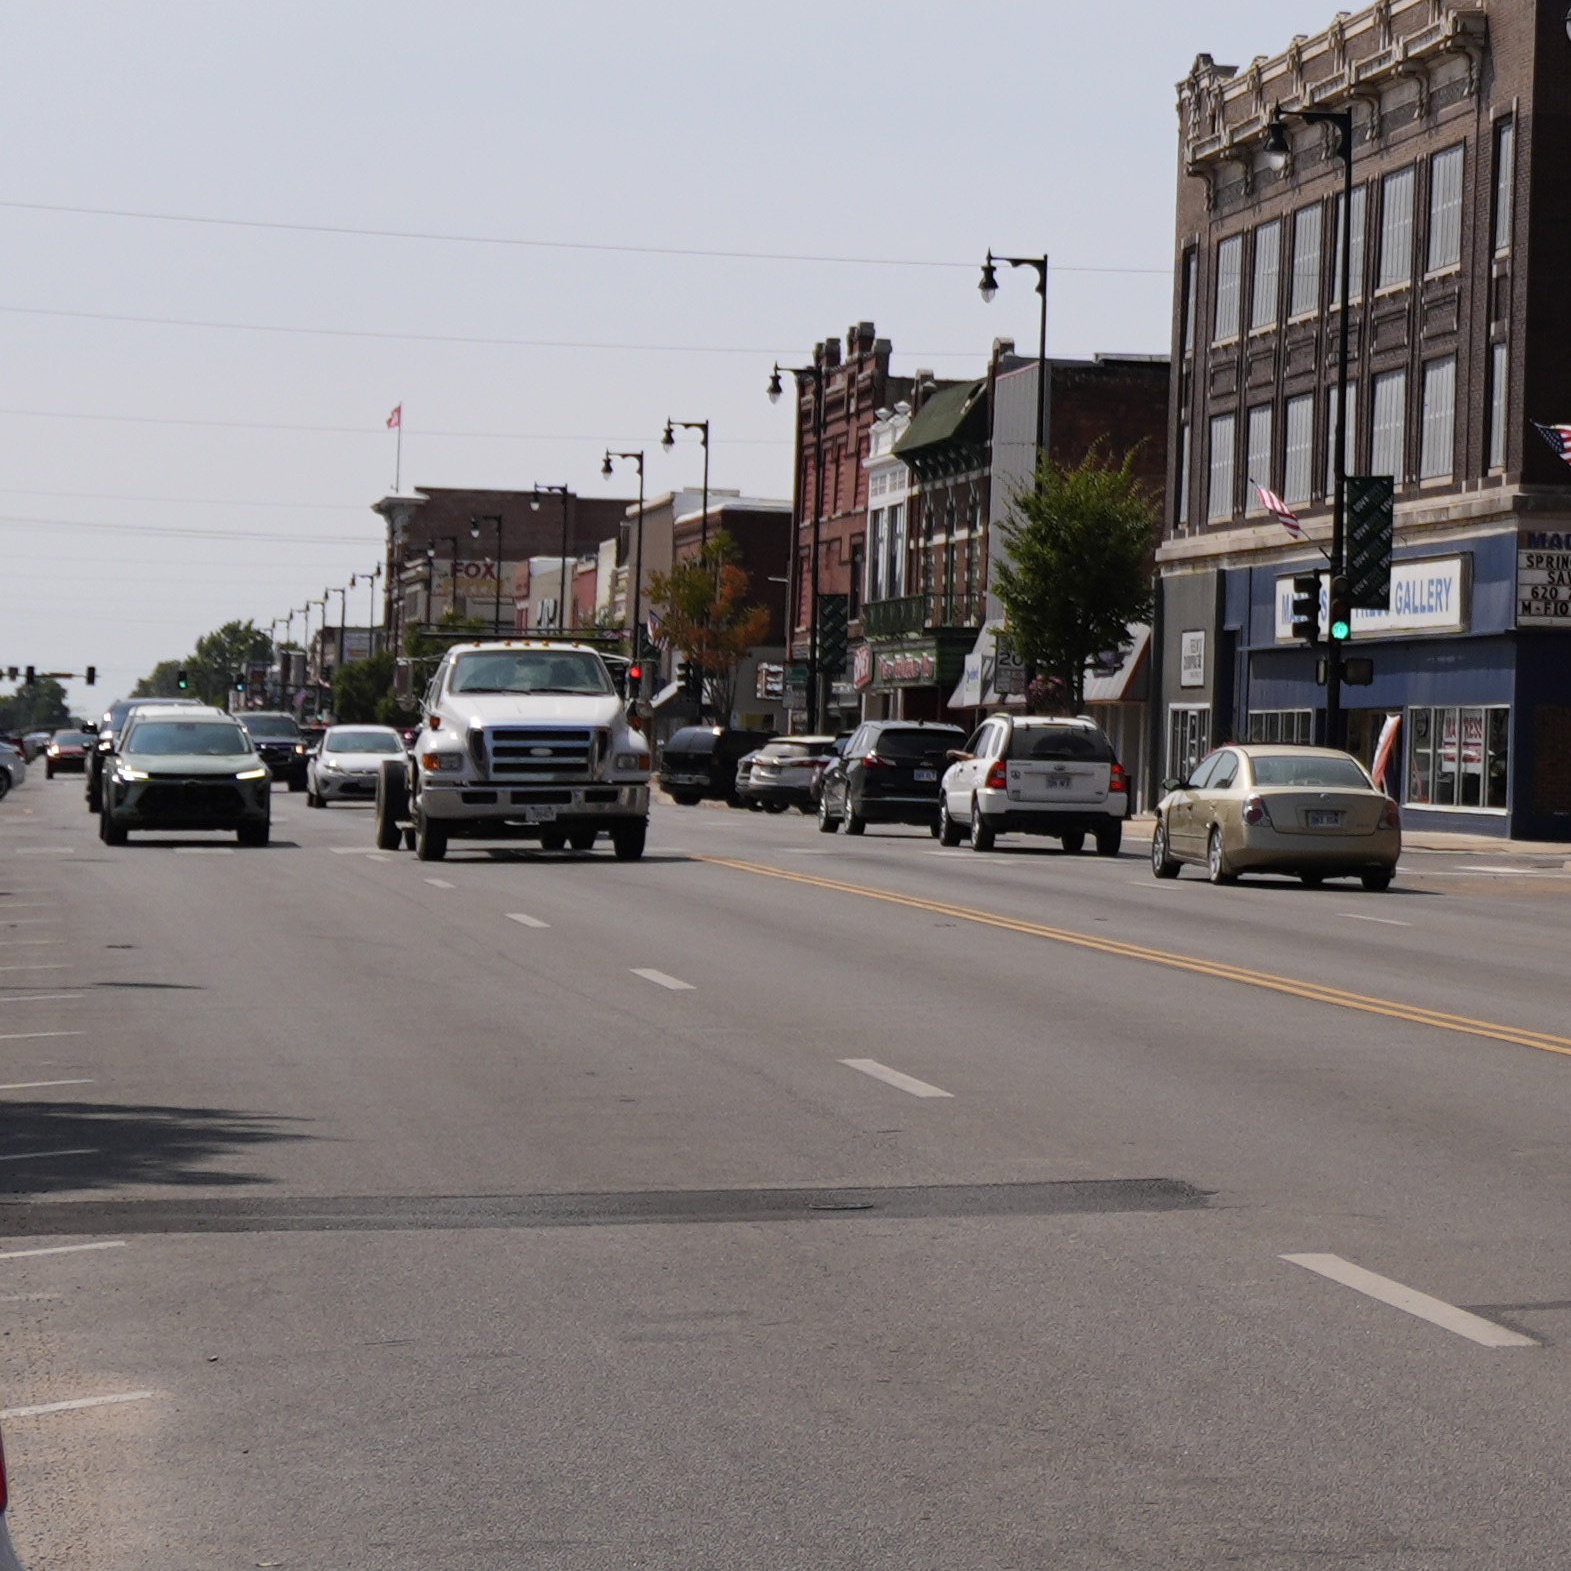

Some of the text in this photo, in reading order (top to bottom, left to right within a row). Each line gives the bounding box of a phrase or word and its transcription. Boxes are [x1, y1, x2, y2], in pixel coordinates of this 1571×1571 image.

[450, 562, 496, 579] FOX
[1395, 577, 1452, 616] GALLERY
[1531, 587, 1558, 600] 620
